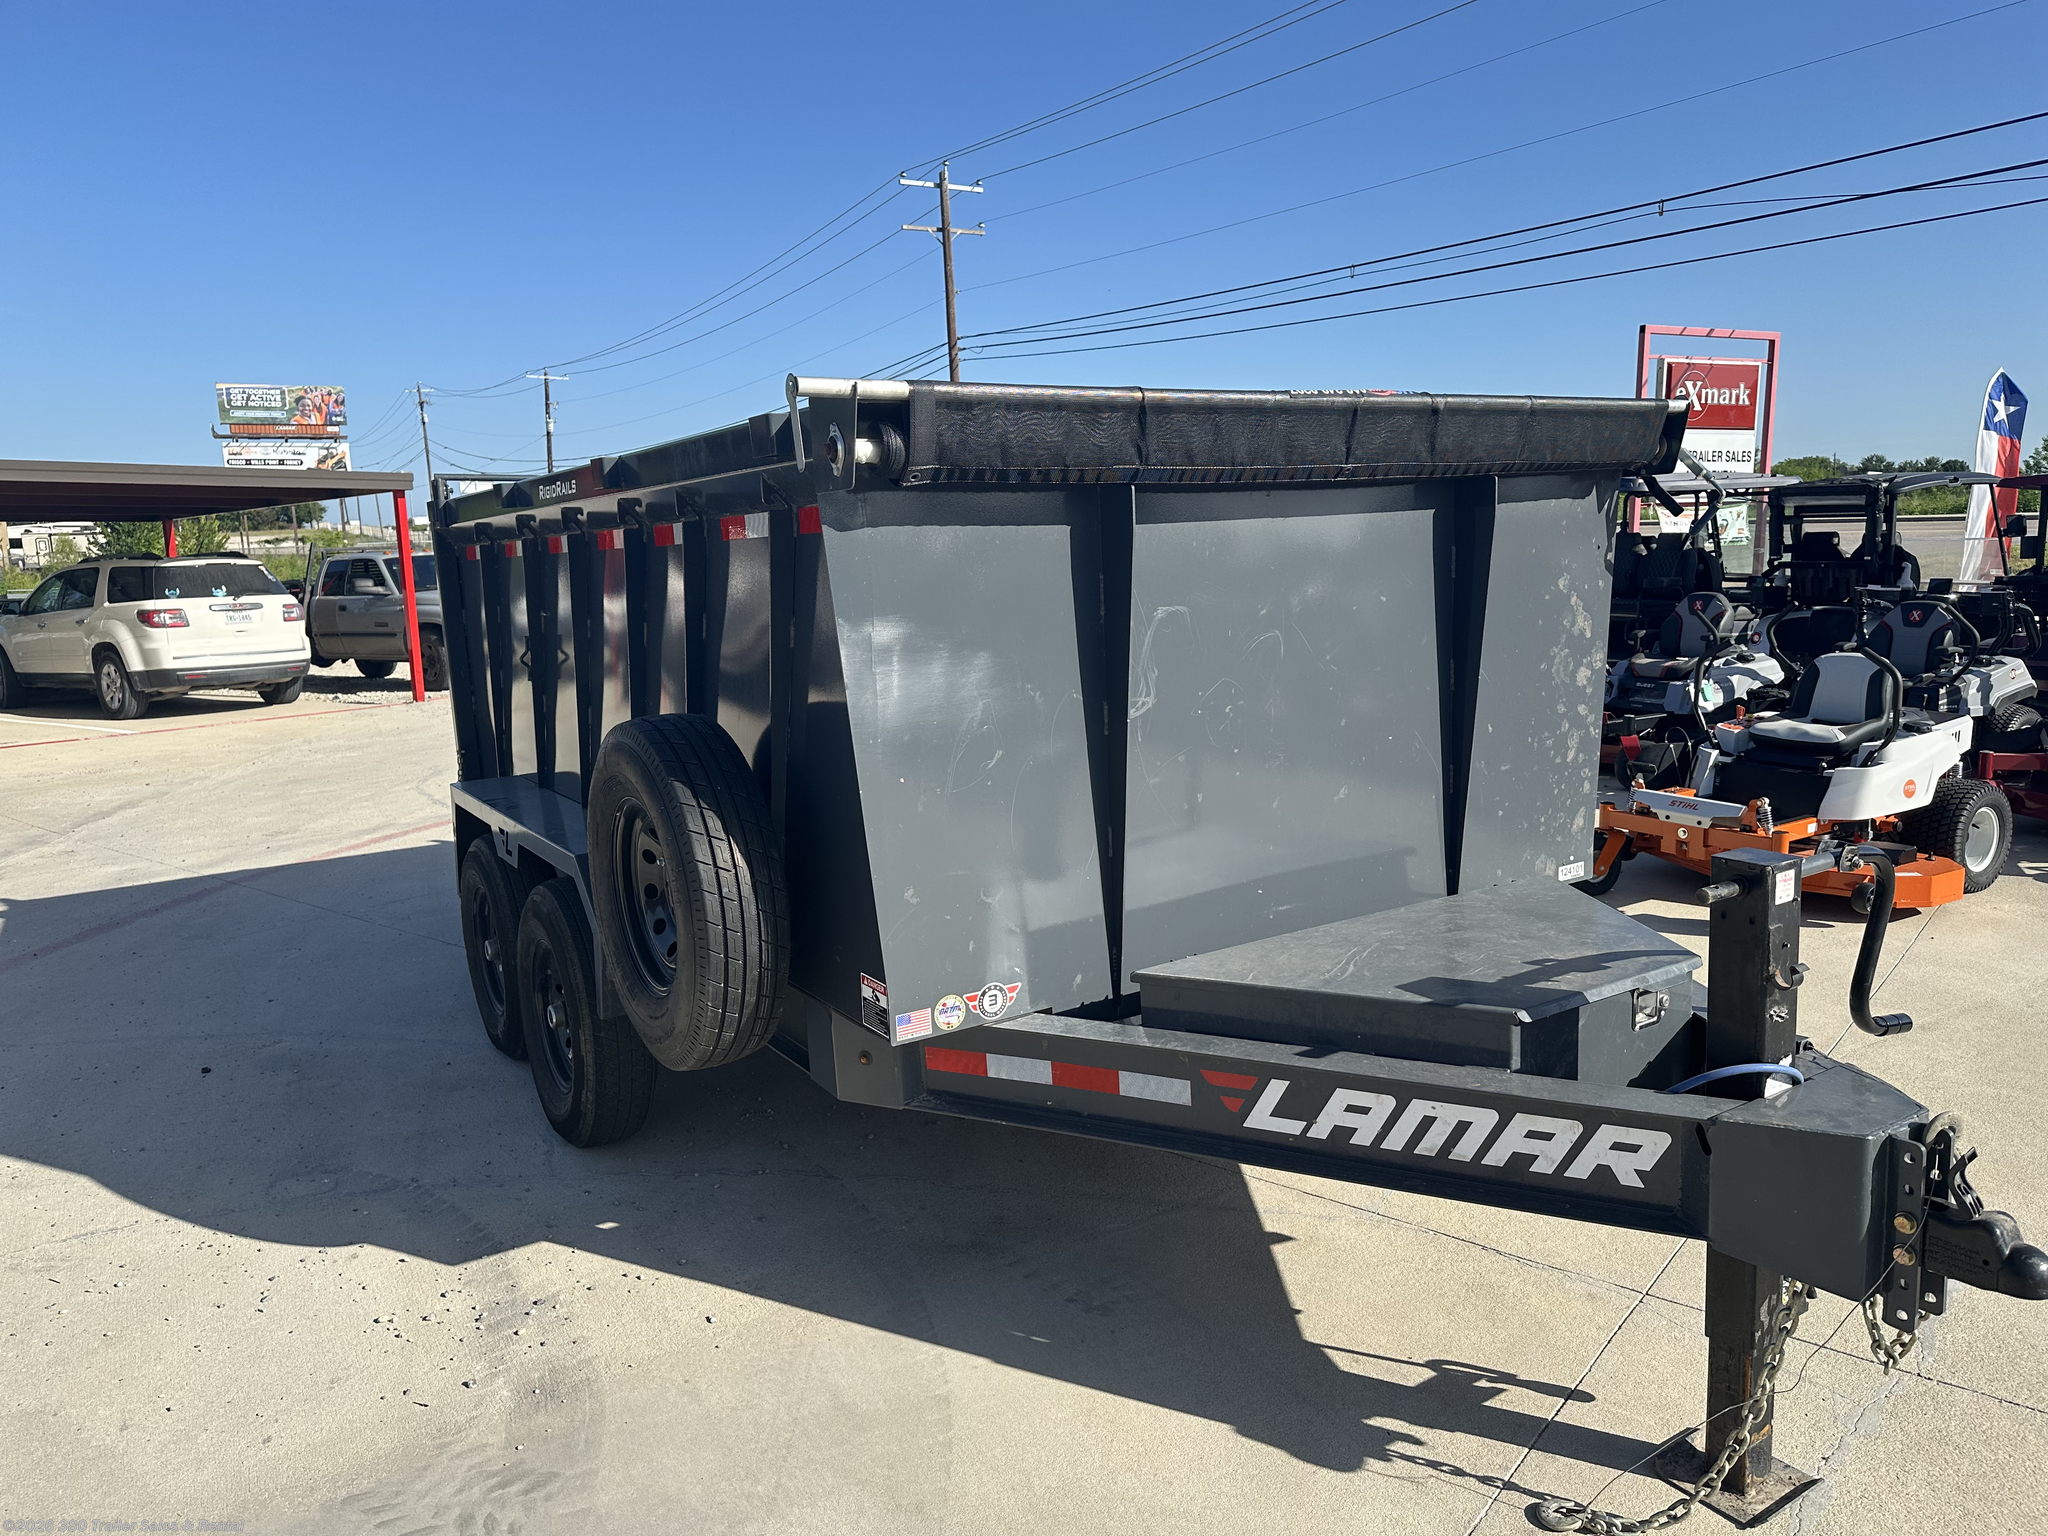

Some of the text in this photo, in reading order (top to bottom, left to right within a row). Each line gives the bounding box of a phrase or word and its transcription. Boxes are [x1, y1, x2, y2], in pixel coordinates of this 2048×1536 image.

[1676, 380, 1750, 411] eXmark
[1725, 450, 1752, 463] SALES
[1911, 610, 1921, 621] X
[1668, 799, 1699, 811] STIHL
[1560, 863, 1583, 876] 124101
[867, 979, 885, 993] DANGER
[988, 993, 998, 1007] 3
[1242, 1078, 1673, 1190] LAMAR
